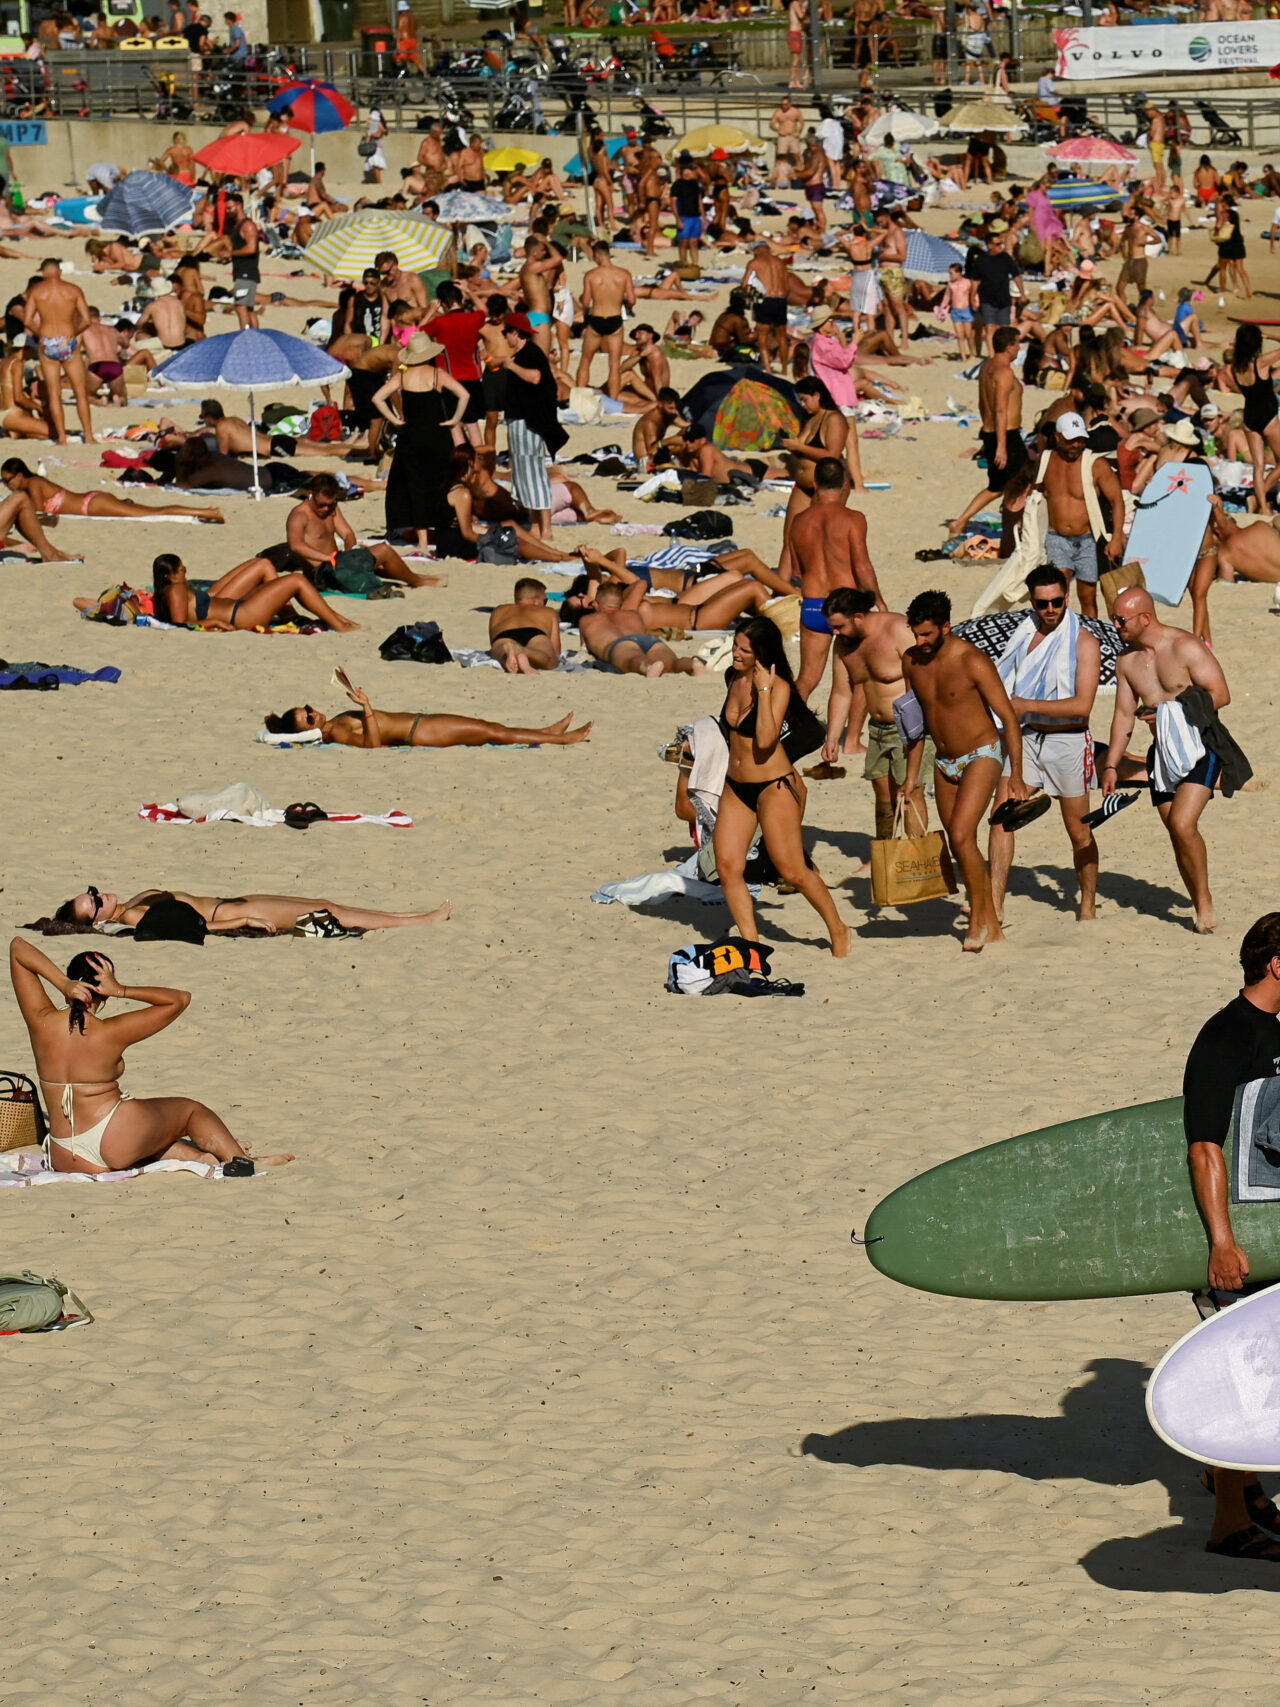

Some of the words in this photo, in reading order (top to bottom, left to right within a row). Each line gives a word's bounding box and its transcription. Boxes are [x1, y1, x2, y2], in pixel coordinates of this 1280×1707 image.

[1217, 34, 1256, 44] OCEAN
[1071, 49, 1163, 61] VOLVO
[1218, 44, 1259, 55] LOVERS
